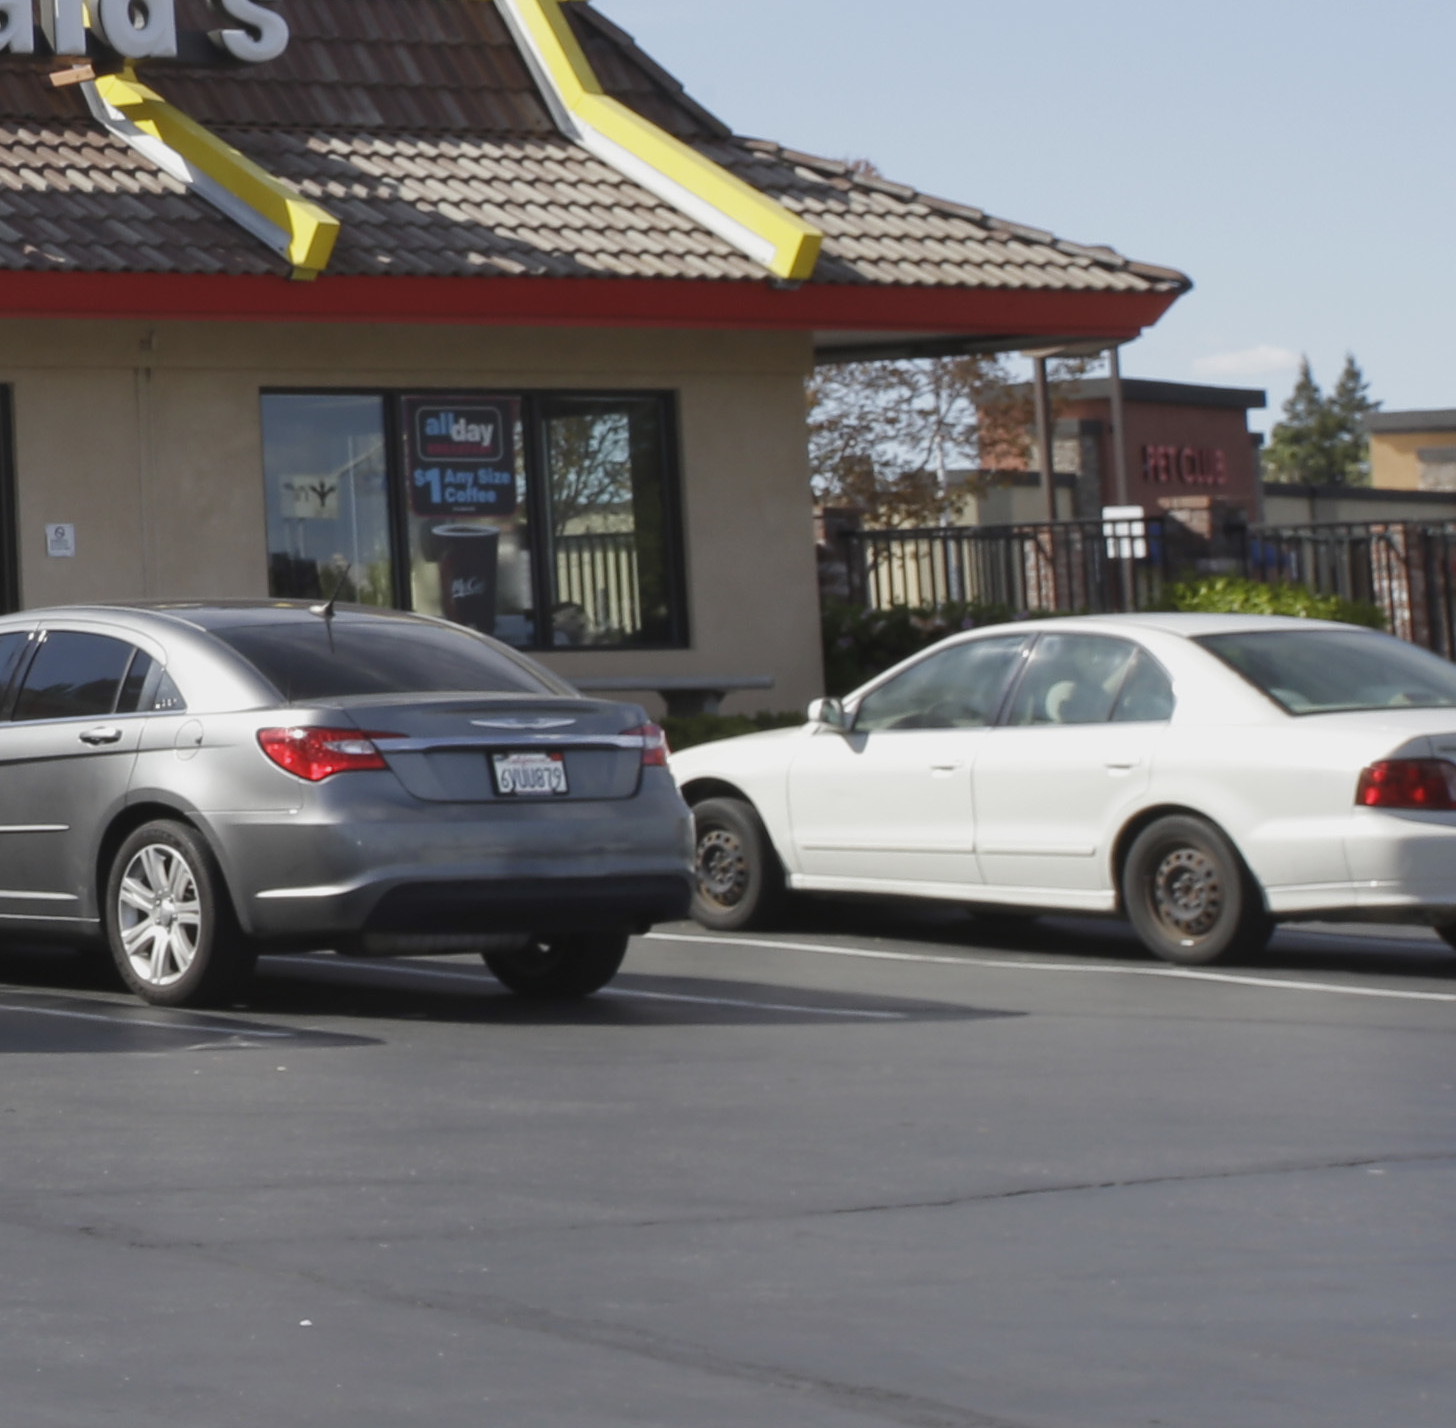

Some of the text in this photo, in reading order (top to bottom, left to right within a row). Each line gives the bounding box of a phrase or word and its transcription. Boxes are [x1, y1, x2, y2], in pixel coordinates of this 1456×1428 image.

[425, 411, 493, 447] all day
[414, 468, 511, 503] $1 Any Size
[444, 487, 496, 503] Coffee
